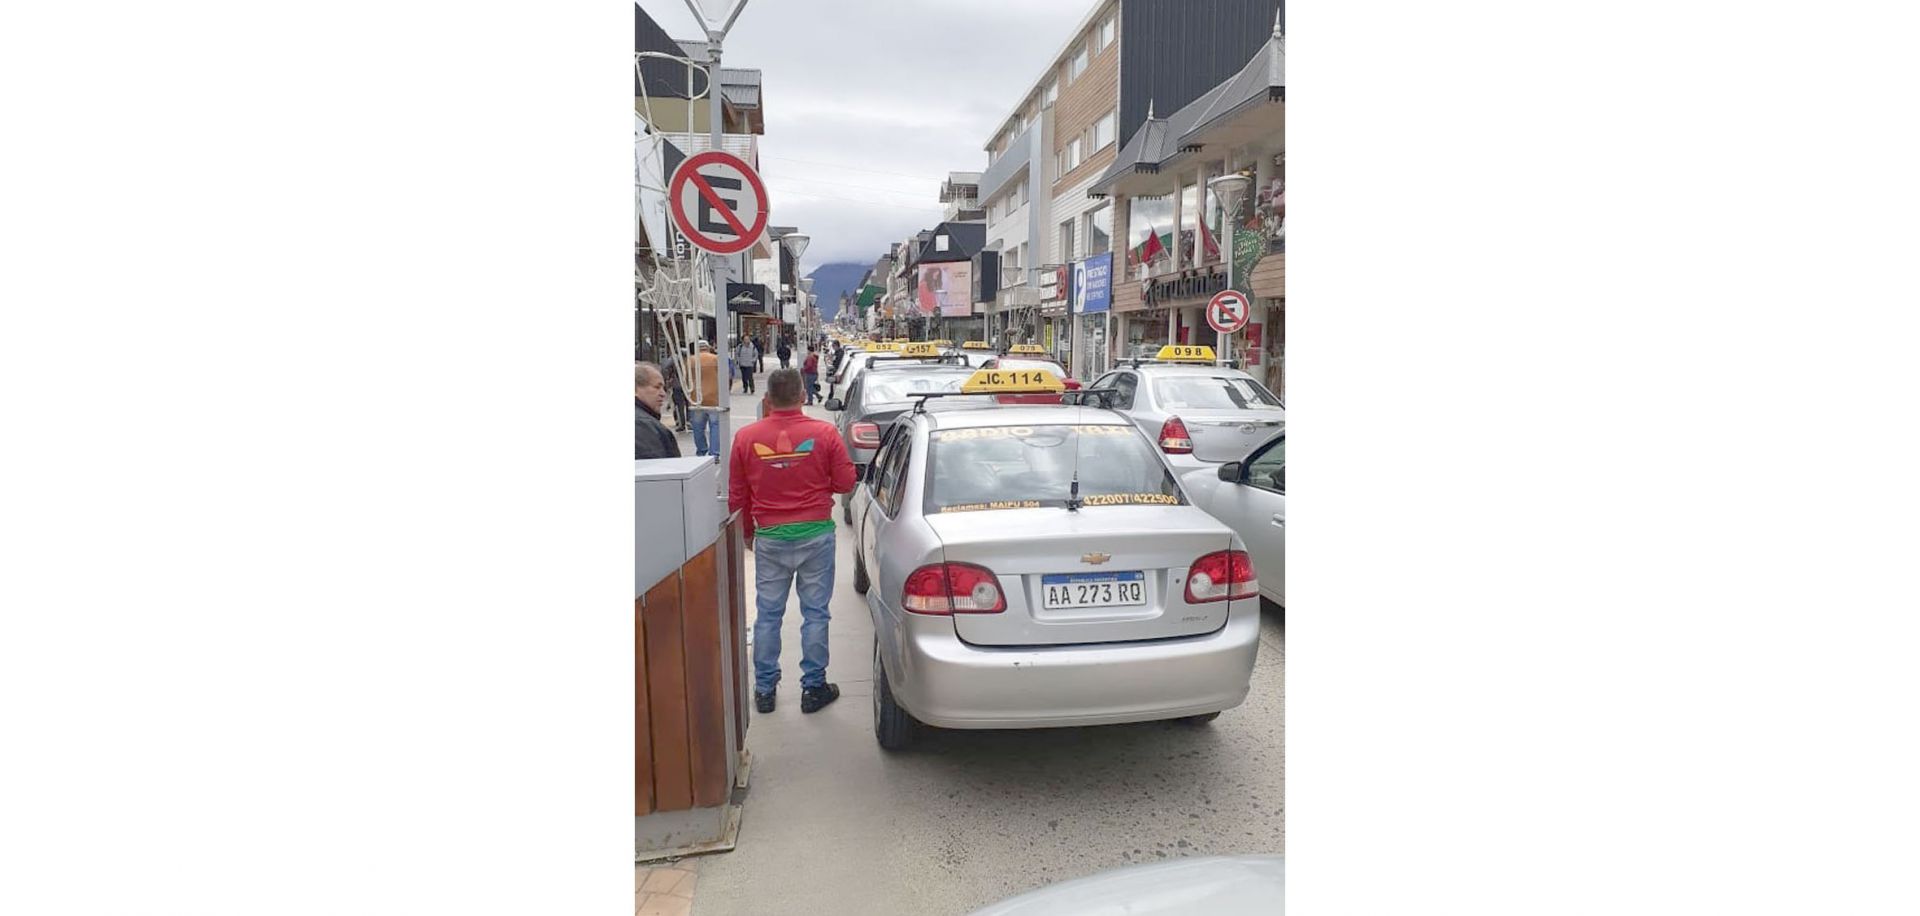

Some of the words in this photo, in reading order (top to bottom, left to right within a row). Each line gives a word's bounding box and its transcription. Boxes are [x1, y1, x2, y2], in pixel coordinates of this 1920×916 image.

[698, 174, 742, 236] E
[1218, 299, 1238, 324] E
[1174, 347, 1202, 356] 098
[1009, 371, 1044, 385] 114
[1049, 585, 1072, 605] AA
[1078, 583, 1112, 604] 273
[1119, 582, 1141, 602] RQ
